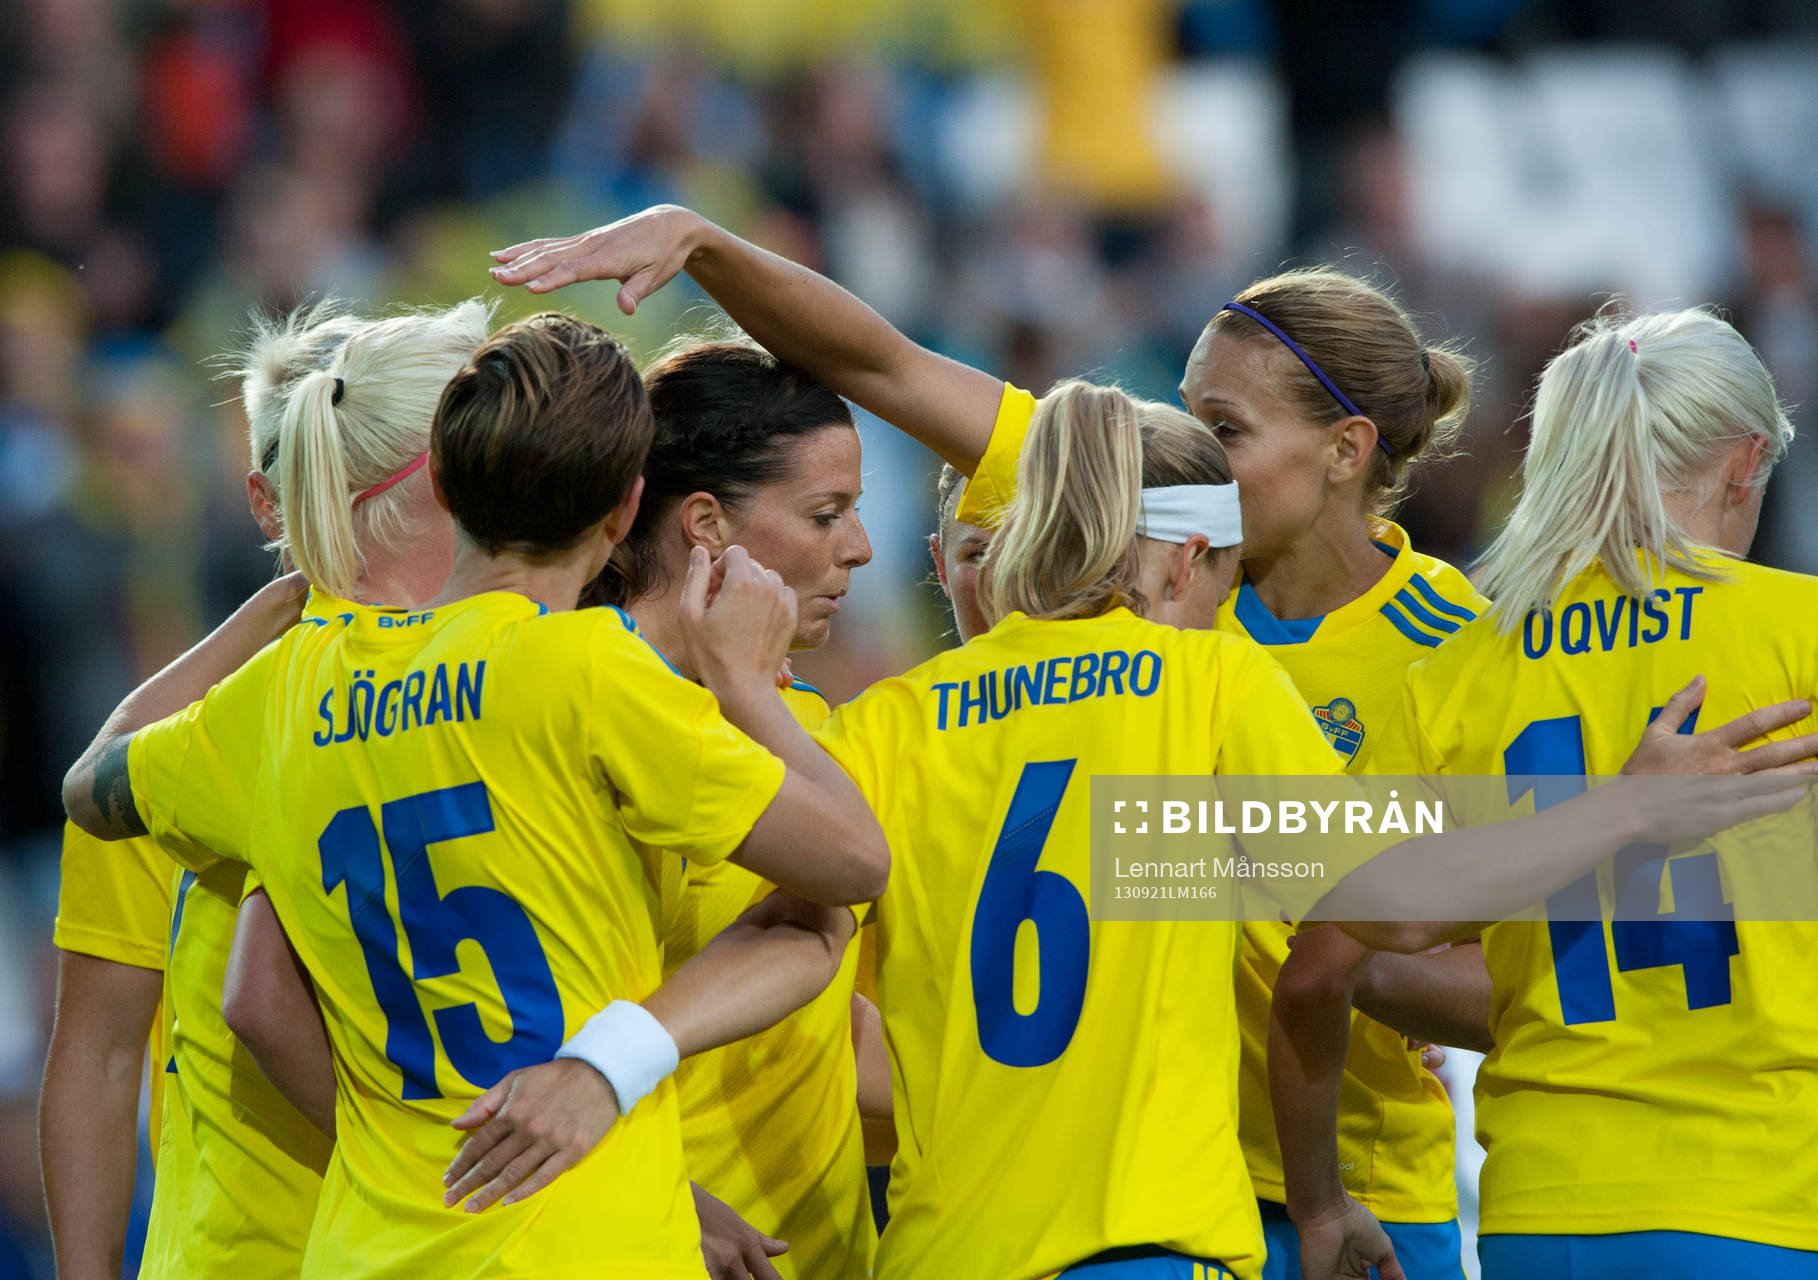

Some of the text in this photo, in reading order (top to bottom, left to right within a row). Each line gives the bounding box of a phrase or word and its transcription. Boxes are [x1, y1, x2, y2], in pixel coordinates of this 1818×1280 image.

[313, 660, 487, 748] SJÖGRAN
[931, 650, 1162, 731] THUNEBRO
[318, 780, 566, 1100] 15
[970, 758, 1091, 1068] 6
[1503, 706, 1740, 1026] 14
